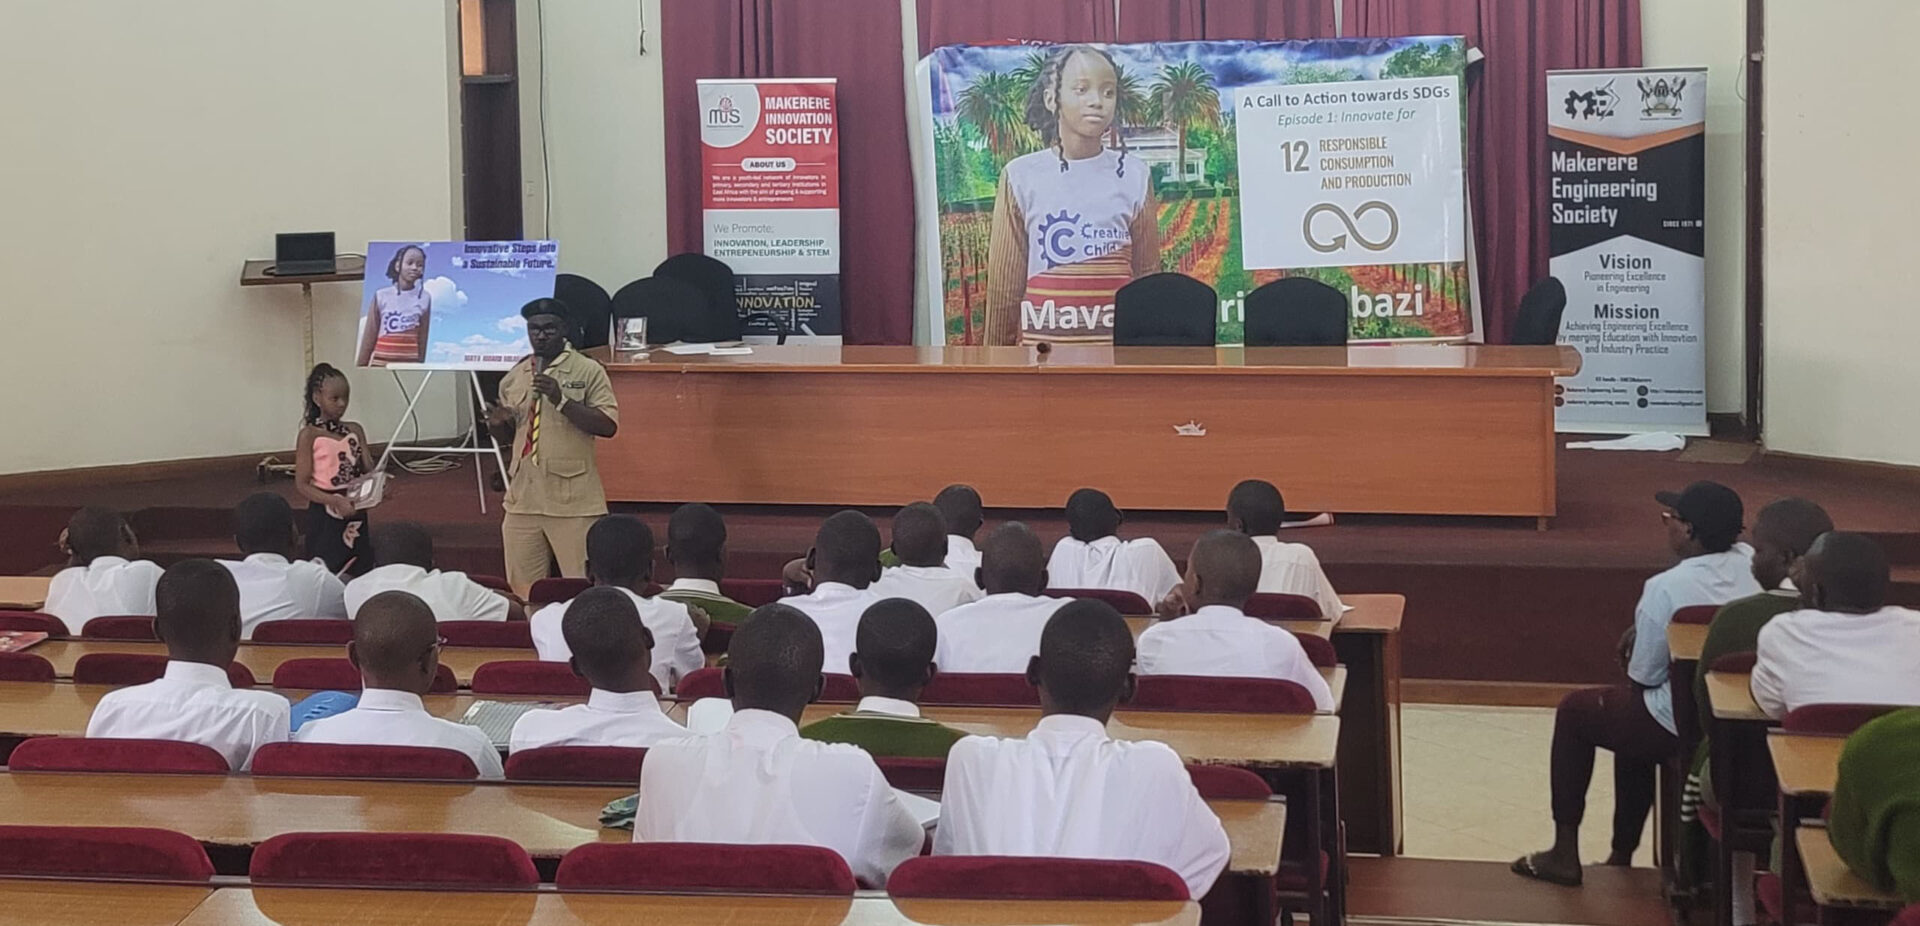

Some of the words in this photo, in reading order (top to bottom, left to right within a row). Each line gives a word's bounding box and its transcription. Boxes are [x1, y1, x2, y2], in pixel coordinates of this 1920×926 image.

[764, 96, 831, 110] MAKERERE
[1243, 96, 1253, 108] A
[1257, 94, 1282, 108] Call
[1286, 95, 1300, 106] to
[1304, 91, 1347, 106] Action
[1352, 88, 1408, 103] towards
[1412, 86, 1450, 100] SDGs
[765, 112, 833, 125] INNOVATION
[1278, 111, 1323, 128] Episode
[1327, 110, 1338, 124] 1:
[1341, 108, 1394, 122] Innovate
[1396, 108, 1416, 122] for
[766, 128, 833, 144] SOCIETY
[1319, 136, 1388, 152] RESPONSIBLE
[1280, 140, 1310, 172] 12
[1320, 156, 1394, 171] CONSUMPTION
[1552, 151, 1638, 172] Makerere
[1321, 176, 1342, 190] AND
[1345, 173, 1412, 188] PRODUCTION
[1552, 177, 1657, 202] Engineering
[1552, 203, 1618, 228] Society
[714, 224, 728, 234] We
[732, 223, 774, 234] Promote:
[464, 244, 510, 253] Innovative
[512, 242, 536, 254] Steps
[540, 243, 556, 253] into
[714, 240, 769, 248] INNOVATION,
[770, 239, 824, 247] LEADERSHIP
[714, 248, 796, 257] ENTREPENEURSHIP
[806, 248, 830, 256] STEM
[462, 260, 468, 268] a
[470, 258, 520, 268] Sustainable
[1599, 254, 1652, 270] Vision
[1584, 271, 1625, 282] Pioneering
[1626, 270, 1666, 282] Excellence
[1597, 284, 1604, 292] in
[1606, 282, 1650, 294] Engineering
[736, 296, 814, 308] NNOVATION
[1220, 290, 1245, 323] ri
[1351, 284, 1424, 318] bazi
[1020, 300, 1115, 331] Mava
[1594, 304, 1660, 320] Mission
[1566, 321, 1600, 332] Achieving
[1603, 321, 1647, 332] Engineering
[1649, 320, 1689, 331] Excellence
[1568, 334, 1600, 344] merging
[1602, 332, 1640, 342] Education
[1643, 332, 1659, 342] with
[1584, 344, 1600, 354] and
[1601, 344, 1633, 355] Industry
[1636, 344, 1669, 354] Practice
